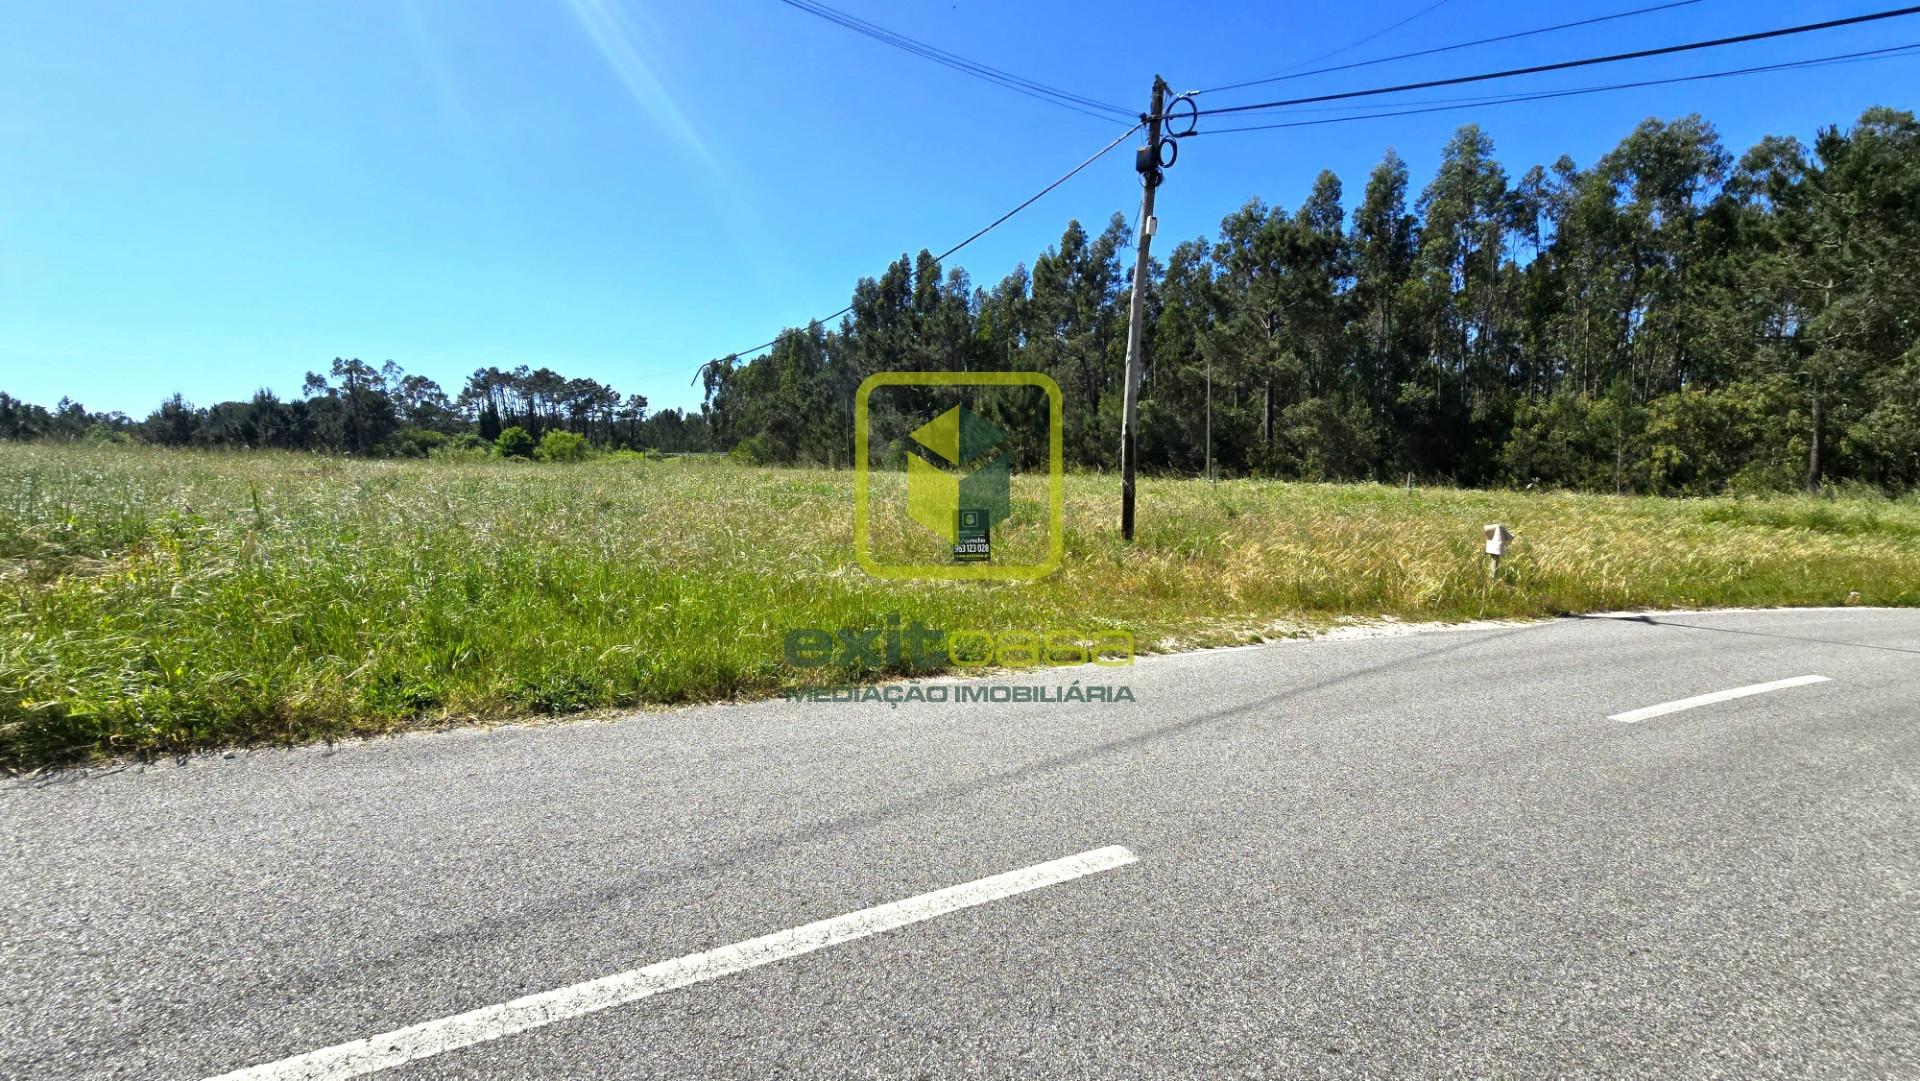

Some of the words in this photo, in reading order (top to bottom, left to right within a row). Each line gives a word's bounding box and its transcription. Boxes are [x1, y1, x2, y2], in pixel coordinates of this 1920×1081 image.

[954, 545, 966, 553] 963
[967, 545, 977, 553] 123
[977, 544, 990, 553] 028
